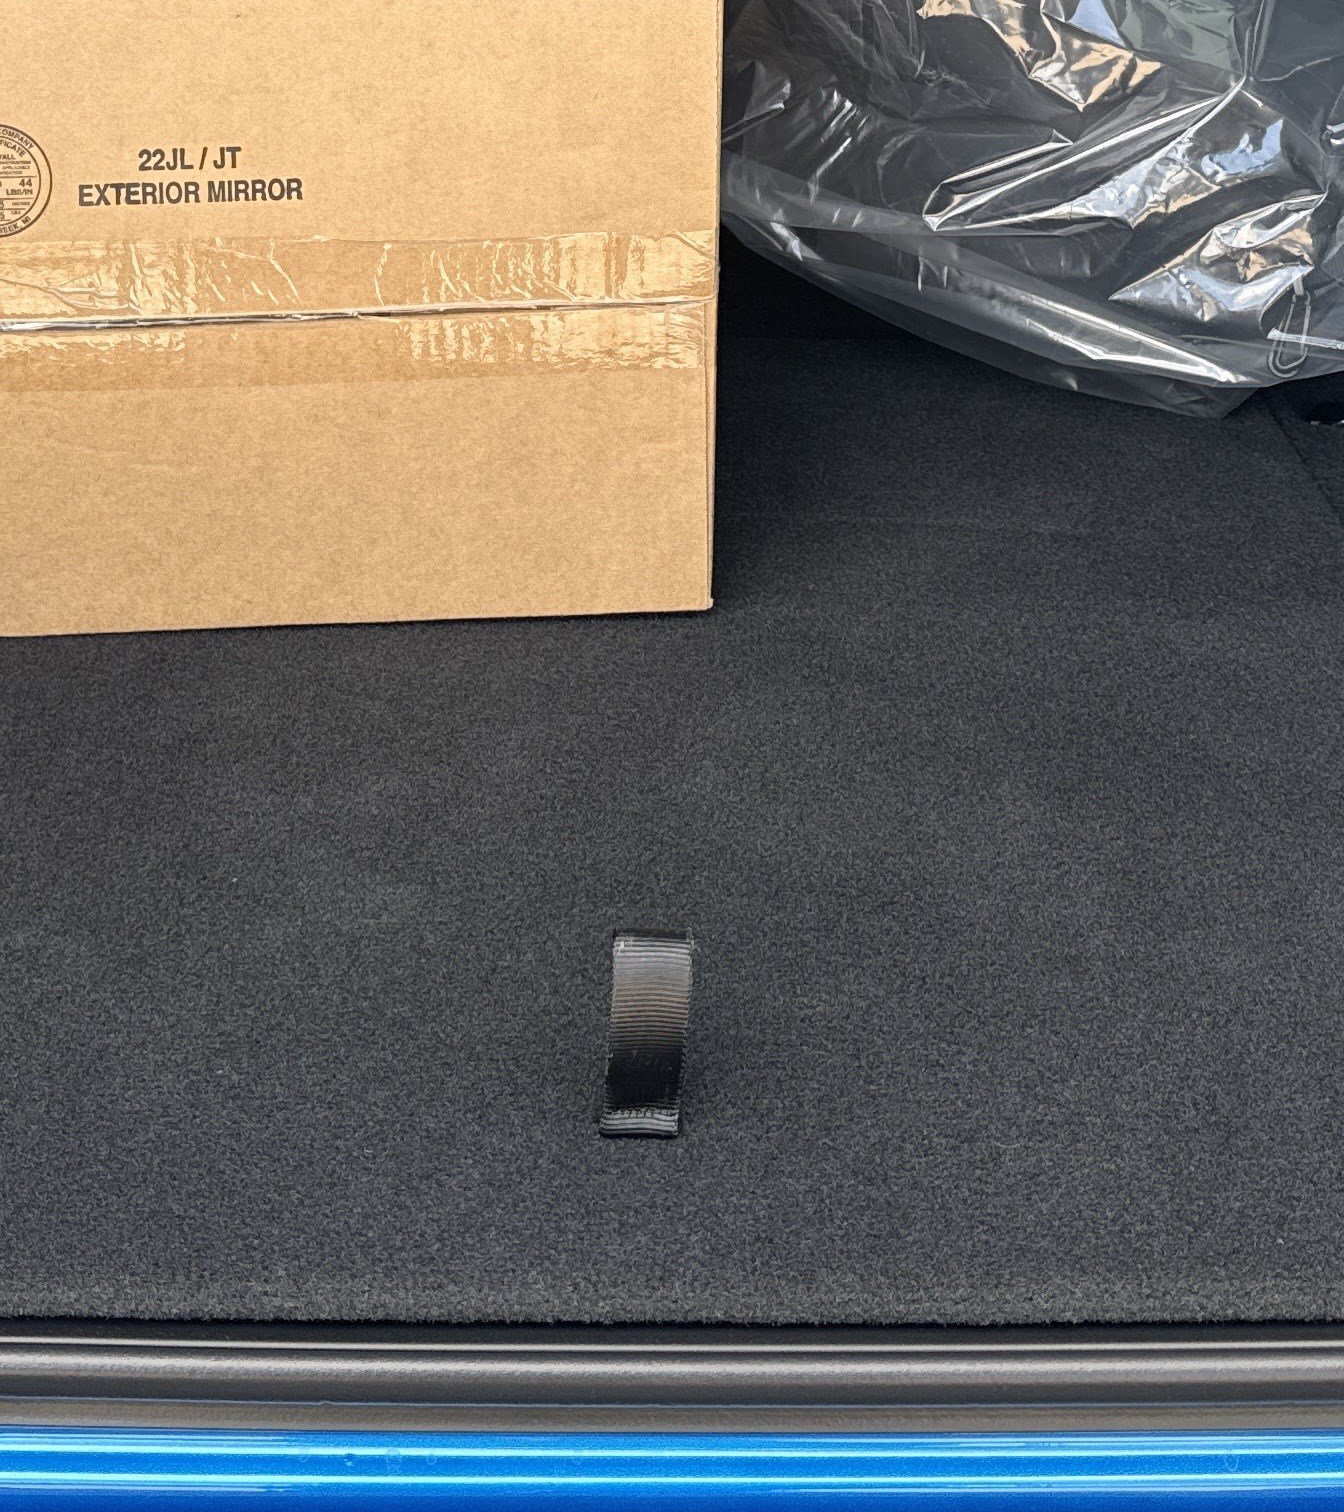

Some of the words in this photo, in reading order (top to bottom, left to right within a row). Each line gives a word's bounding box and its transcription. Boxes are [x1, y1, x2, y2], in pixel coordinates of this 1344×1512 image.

[138, 148, 194, 171] 22JL
[199, 147, 208, 170] /
[213, 147, 242, 169] JT
[19, 179, 33, 187] 44
[78, 181, 201, 206] EXTERIOR
[207, 178, 303, 202] MIRROR
[22, 216, 31, 224] MI
